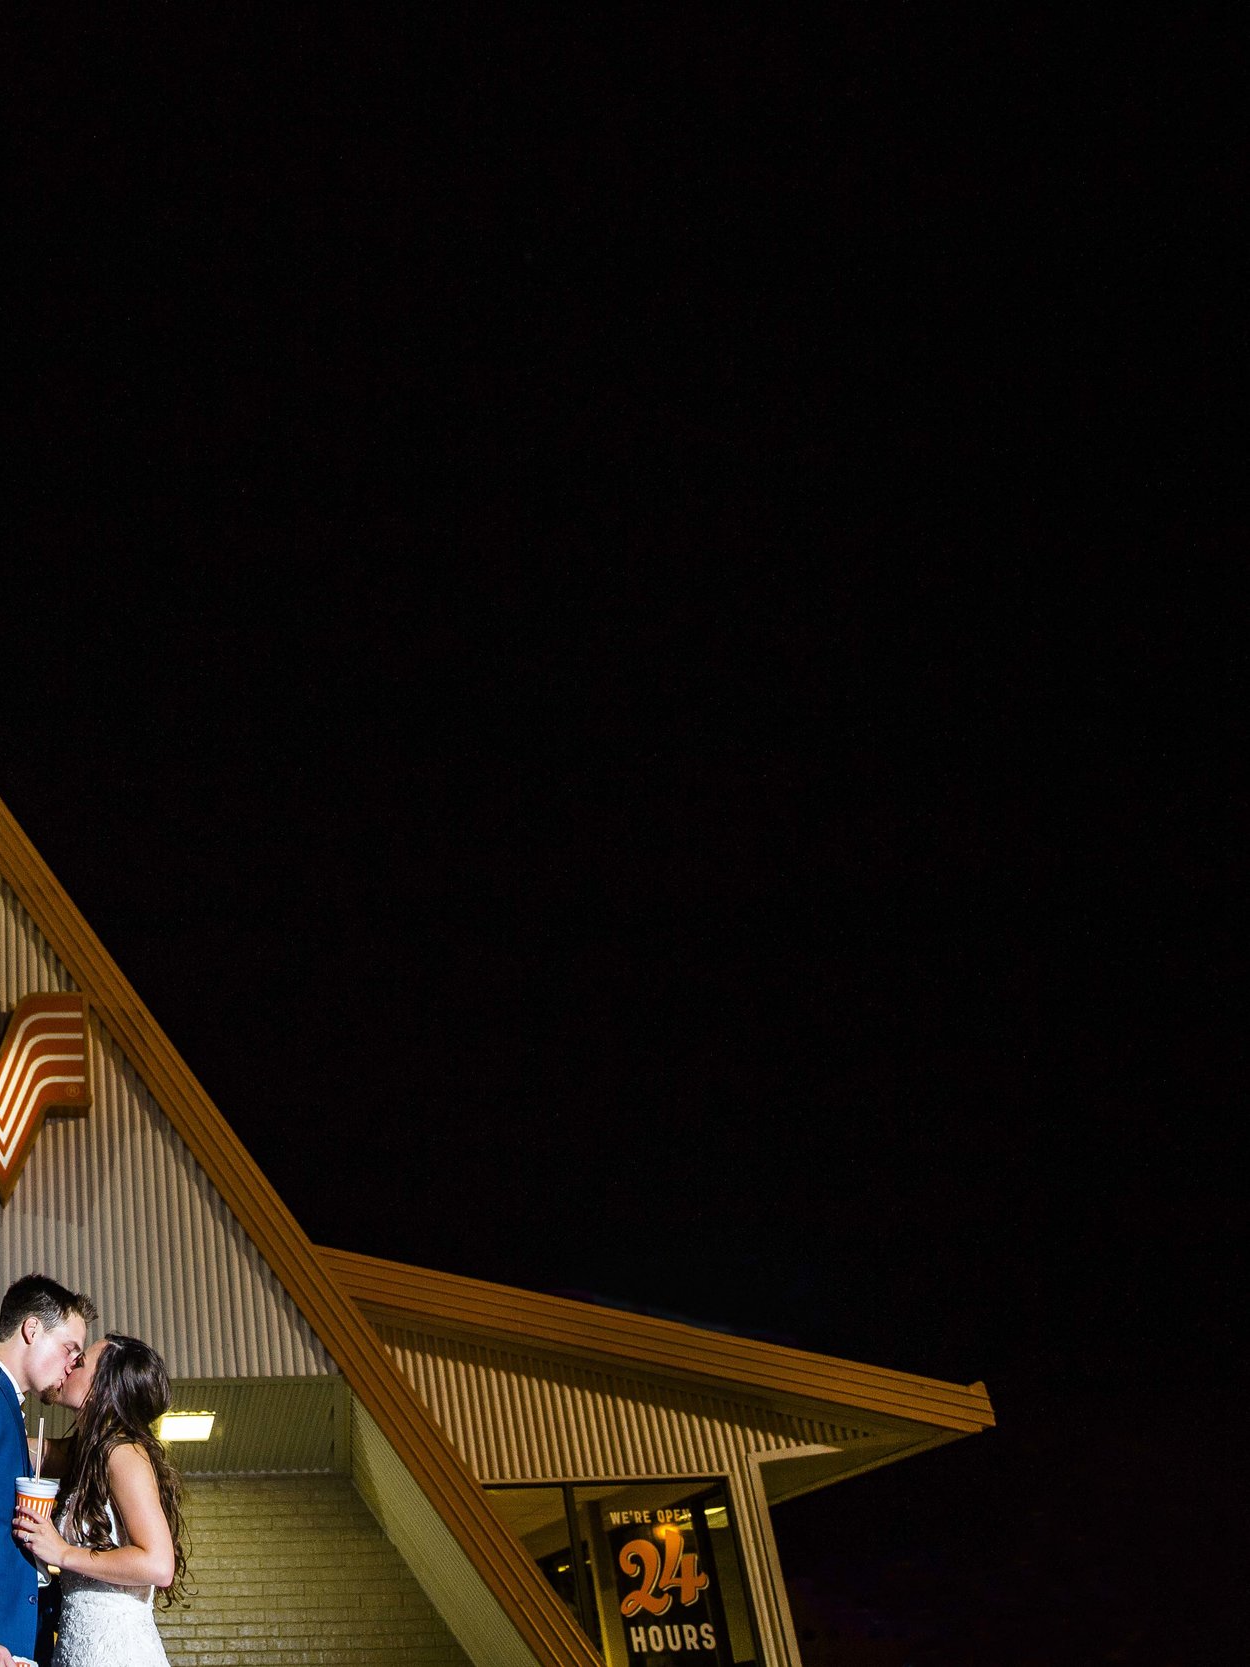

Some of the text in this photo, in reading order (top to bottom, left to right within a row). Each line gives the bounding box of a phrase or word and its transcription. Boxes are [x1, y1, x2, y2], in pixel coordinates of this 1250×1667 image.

[609, 1508, 692, 1525] WE'RE OPEN
[619, 1529, 710, 1618] 24
[630, 1622, 717, 1653] HOURS
